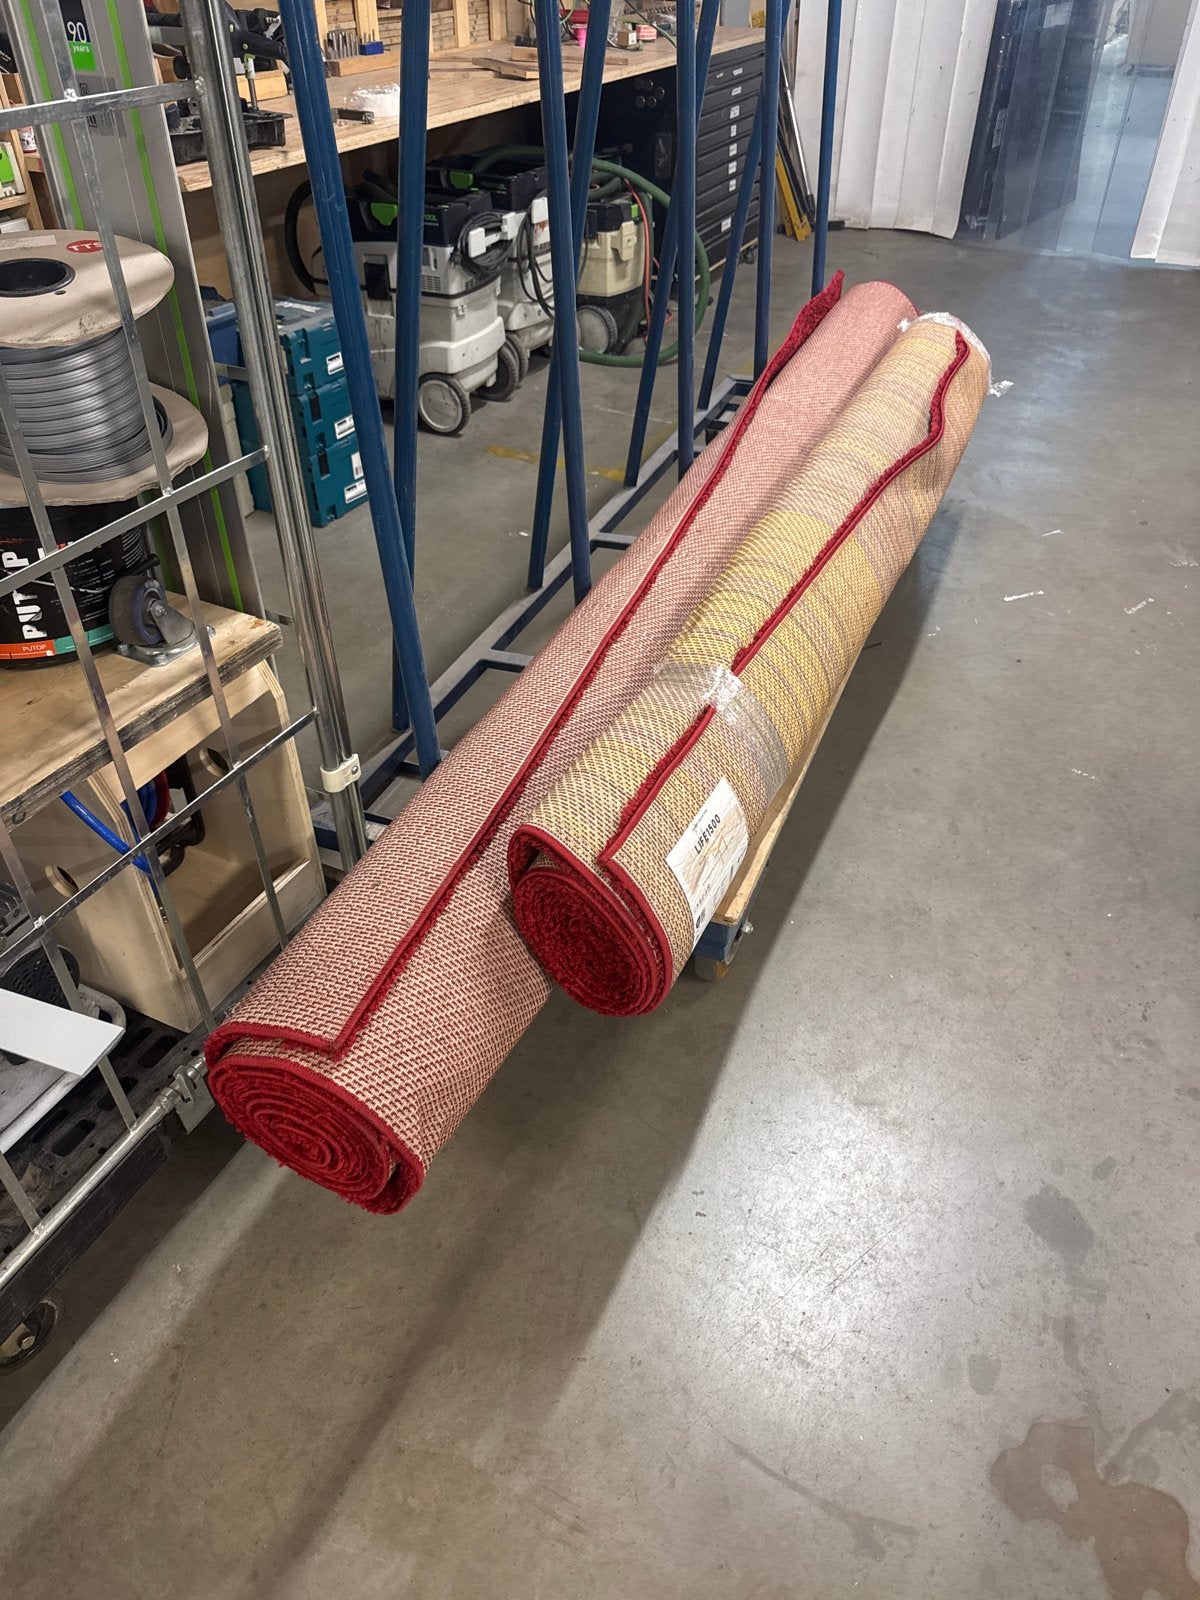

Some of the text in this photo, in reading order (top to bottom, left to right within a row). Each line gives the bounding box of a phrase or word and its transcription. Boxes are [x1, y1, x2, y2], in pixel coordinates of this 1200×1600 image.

[67, 21, 87, 43] 90
[72, 45, 90, 53] years
[1, 551, 48, 639] PUTP
[22, 644, 47, 652] PUTOP
[694, 814, 721, 854] LIFE1500
